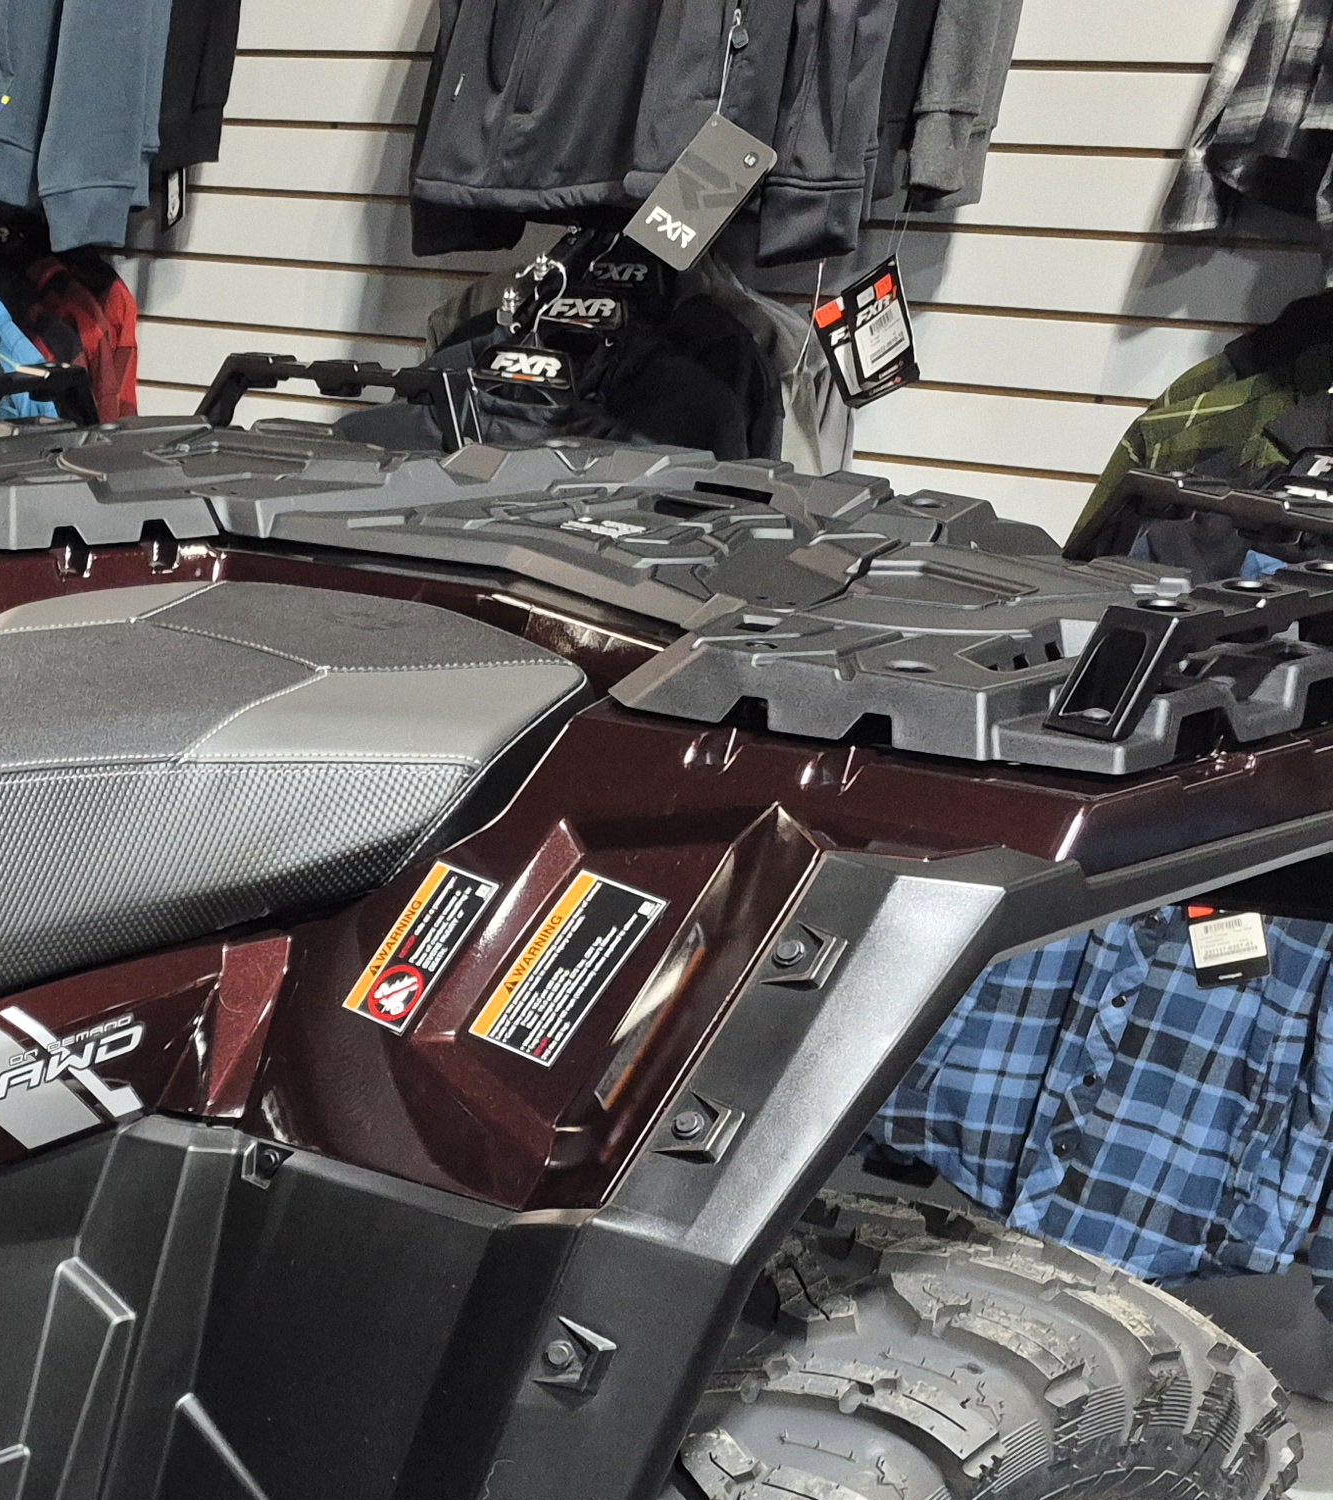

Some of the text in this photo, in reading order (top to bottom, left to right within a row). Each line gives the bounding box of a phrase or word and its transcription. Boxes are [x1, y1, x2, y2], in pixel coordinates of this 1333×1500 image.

[645, 206, 696, 248] FXR
[594, 263, 648, 282] FXR
[549, 298, 617, 317] FXR
[490, 352, 563, 378] FXR
[376, 899, 424, 961] WARNING
[513, 914, 564, 979] WARNING
[8, 1015, 132, 1067] ON DEMAND
